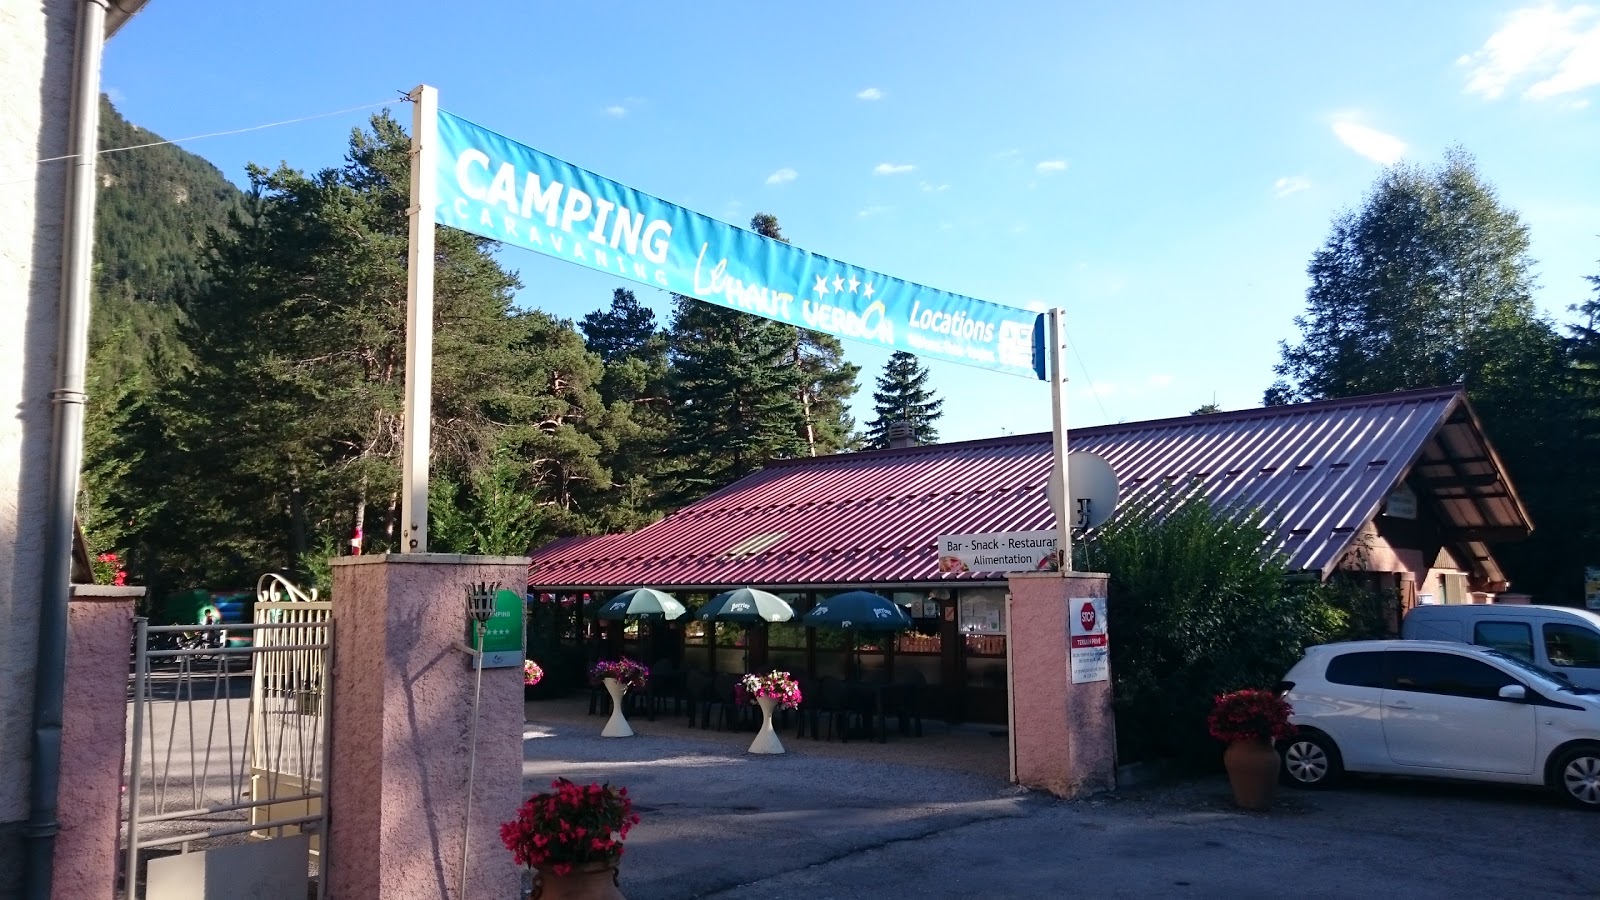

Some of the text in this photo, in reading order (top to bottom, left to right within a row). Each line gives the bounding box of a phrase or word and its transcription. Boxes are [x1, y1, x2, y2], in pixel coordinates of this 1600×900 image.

[455, 148, 673, 265] CAMPING
[453, 198, 669, 287] CARAVANING
[725, 279, 794, 320] HAUT
[908, 300, 995, 344] Locations
[947, 541, 962, 552] Bar
[971, 539, 999, 551] Snack
[973, 553, 1033, 566] Alimentation
[1081, 611, 1095, 623] STOP
